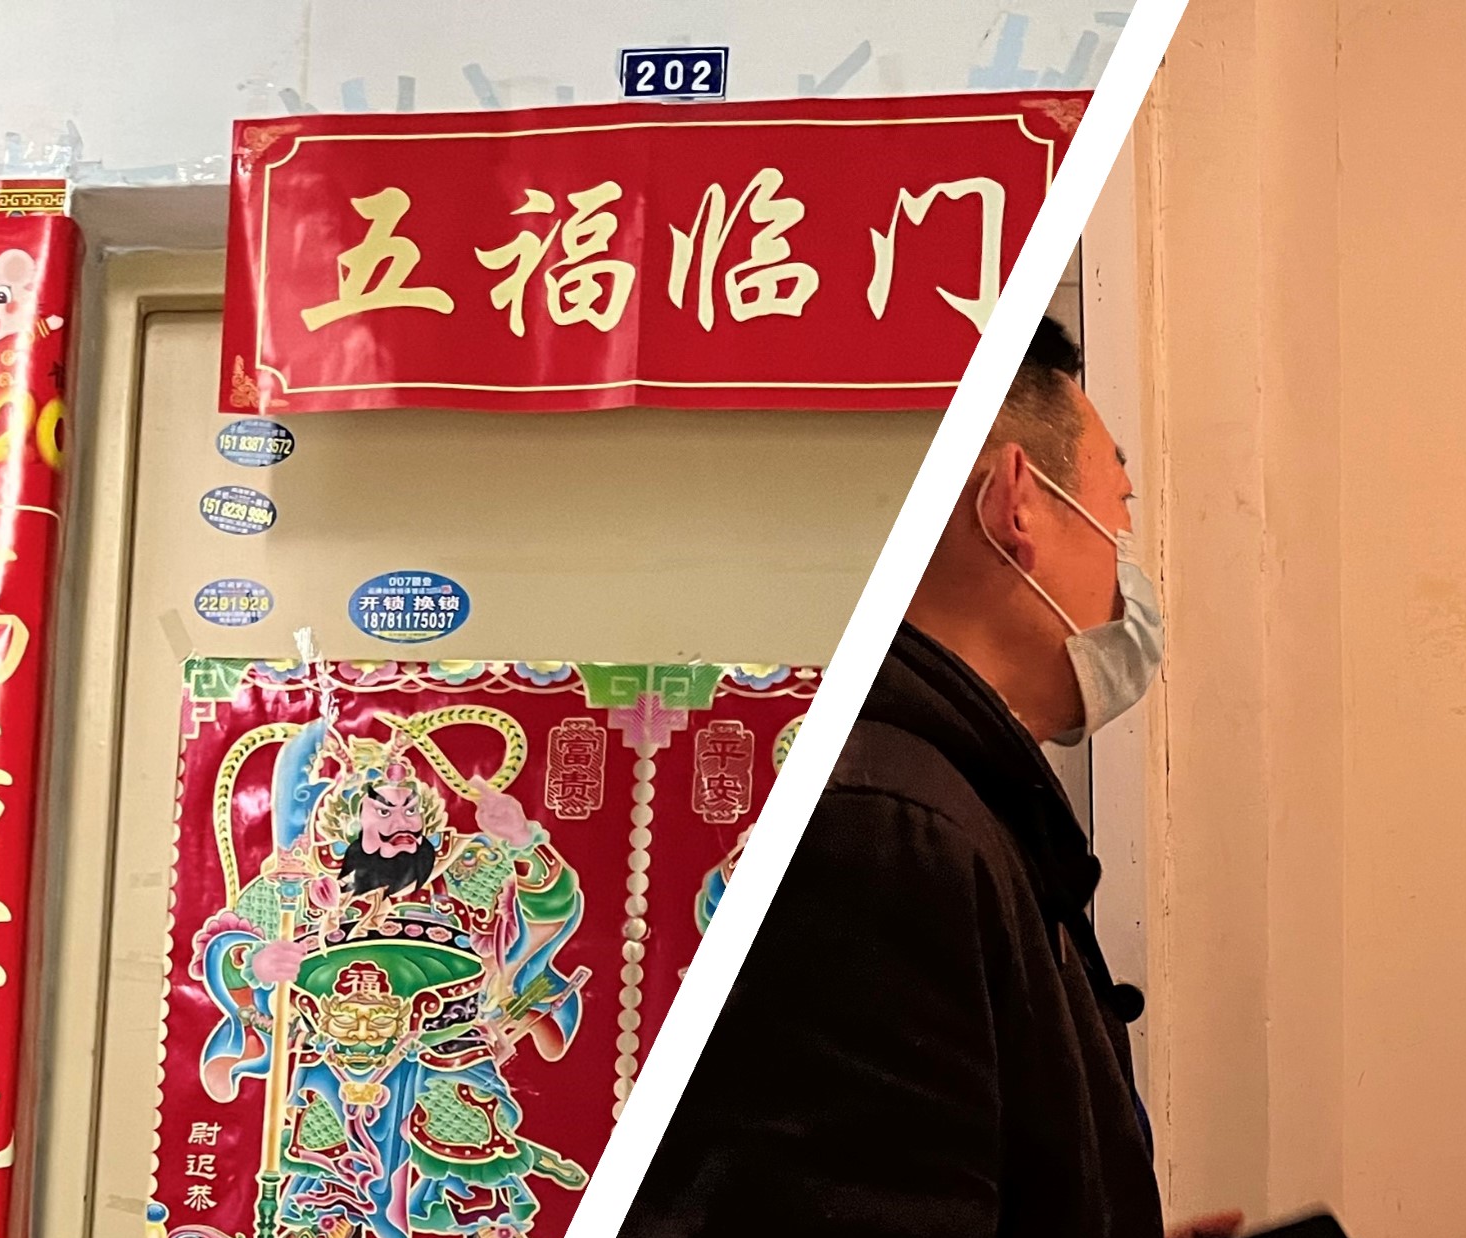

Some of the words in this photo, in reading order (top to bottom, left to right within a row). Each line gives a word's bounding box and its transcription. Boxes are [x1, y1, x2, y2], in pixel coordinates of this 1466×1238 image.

[636, 58, 712, 92] 202
[301, 167, 1006, 337] 五福临门
[219, 434, 237, 450] 151
[203, 497, 221, 515] 151
[359, 596, 406, 611] 开锁
[413, 596, 460, 611] 换锁
[363, 612, 455, 629] 18781175037
[552, 736, 598, 801] 富贵
[700, 738, 746, 806] 平安
[343, 969, 380, 995] 福
[183, 1121, 221, 1212] 尉迟恭
